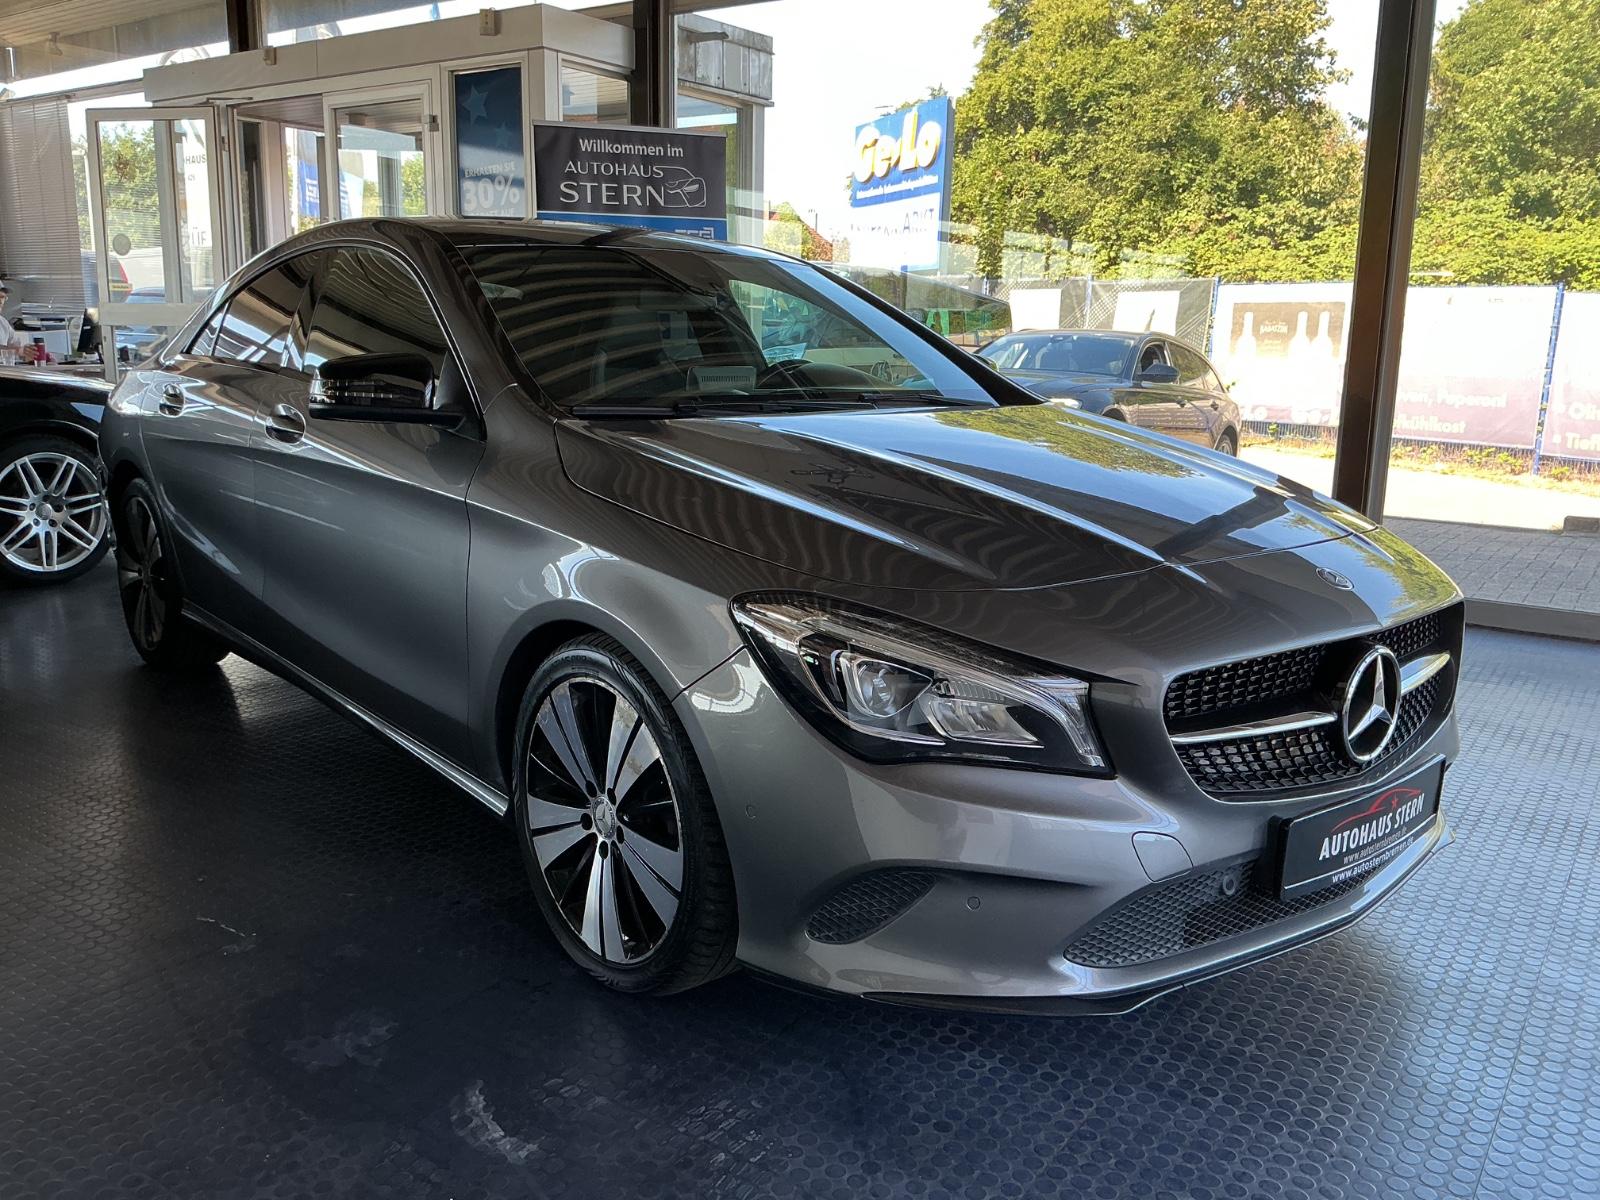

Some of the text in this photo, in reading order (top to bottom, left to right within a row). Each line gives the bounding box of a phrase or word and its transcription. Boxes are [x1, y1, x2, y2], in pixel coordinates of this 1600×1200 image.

[579, 138, 684, 158] Willkommen im
[564, 160, 664, 178] AUTOHAUS
[463, 174, 520, 211] 30%
[560, 181, 665, 207] STERN
[1319, 793, 1425, 860] AUTOHAUS STERN
[1332, 836, 1414, 883] www.autosternbremen.de
